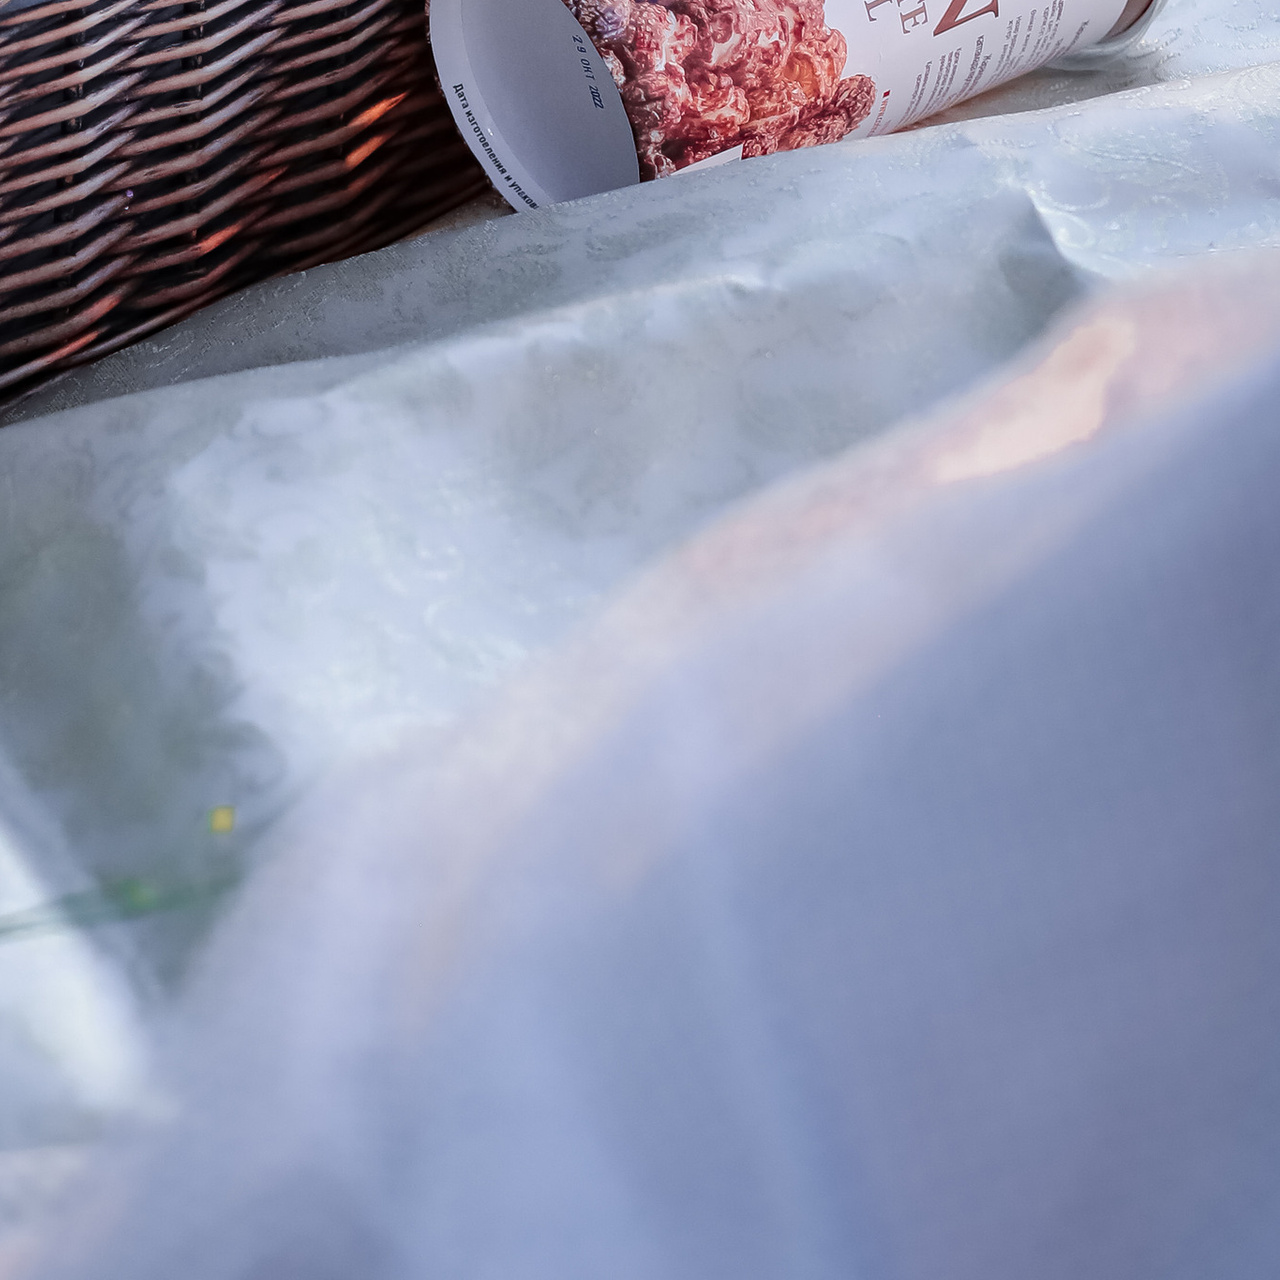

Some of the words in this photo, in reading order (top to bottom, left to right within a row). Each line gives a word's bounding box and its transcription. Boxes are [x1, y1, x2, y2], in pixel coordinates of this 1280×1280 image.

[589, 84, 604, 110] 2022
[453, 83, 468, 110] Дата
[465, 109, 507, 176] изготовления
